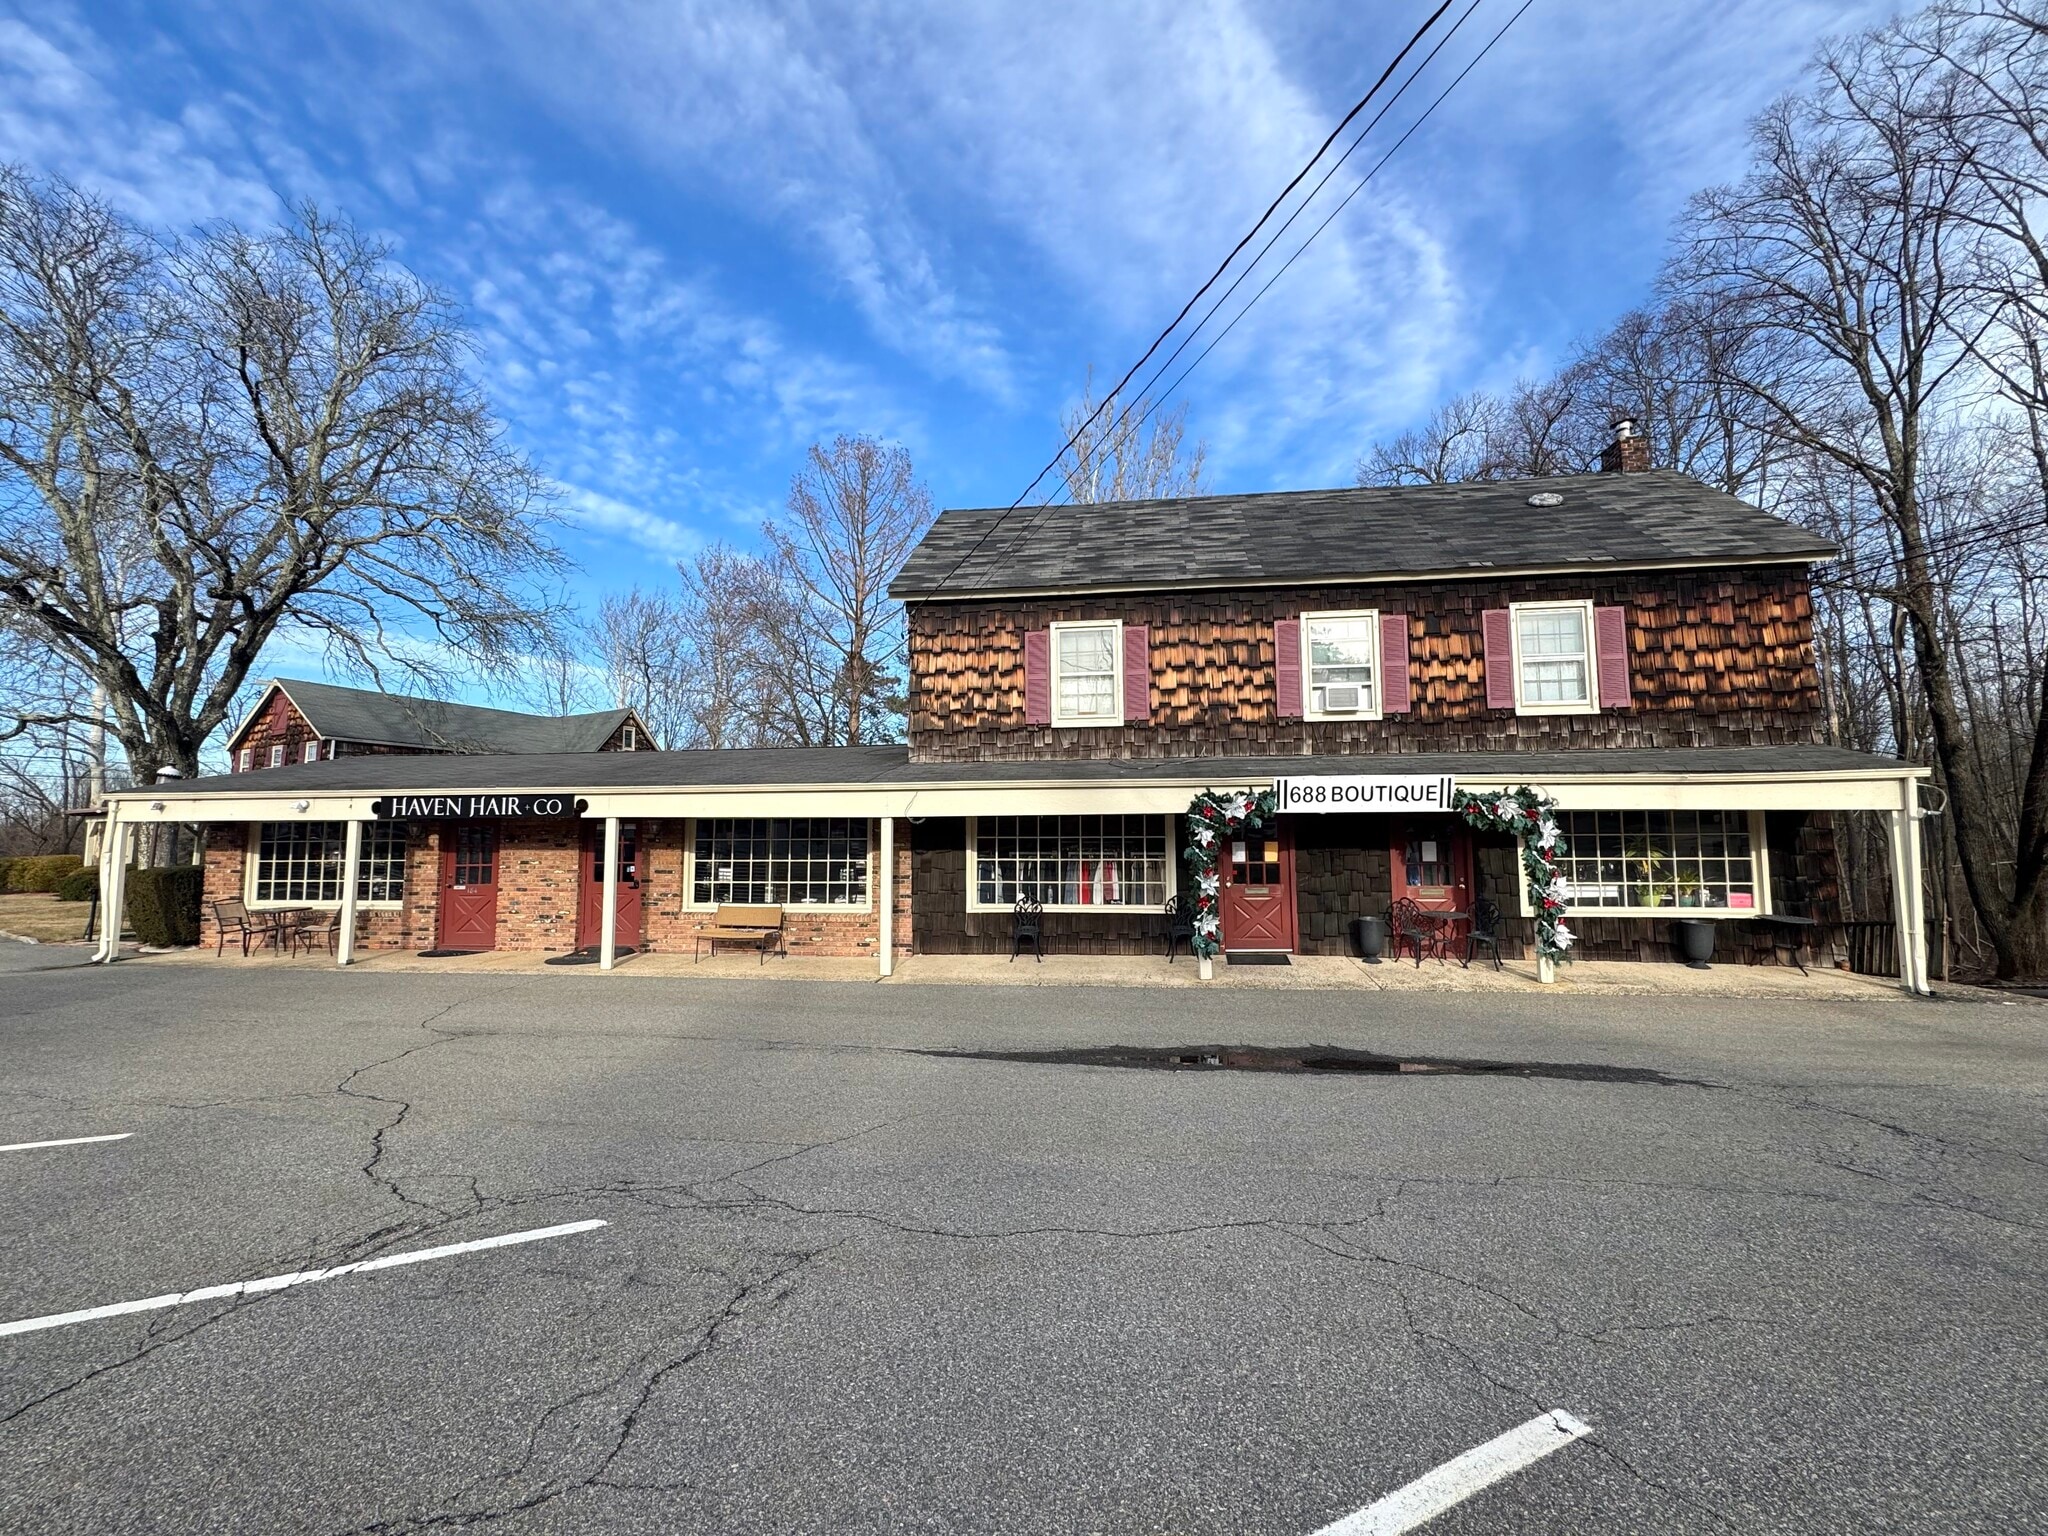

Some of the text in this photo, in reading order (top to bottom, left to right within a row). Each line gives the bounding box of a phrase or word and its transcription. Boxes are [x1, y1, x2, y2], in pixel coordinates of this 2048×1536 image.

[1289, 785, 1438, 803] 688 BOUTIQUE
[391, 796, 462, 817] HAVEN
[469, 795, 523, 817] HAIR
[533, 798, 563, 815] CO
